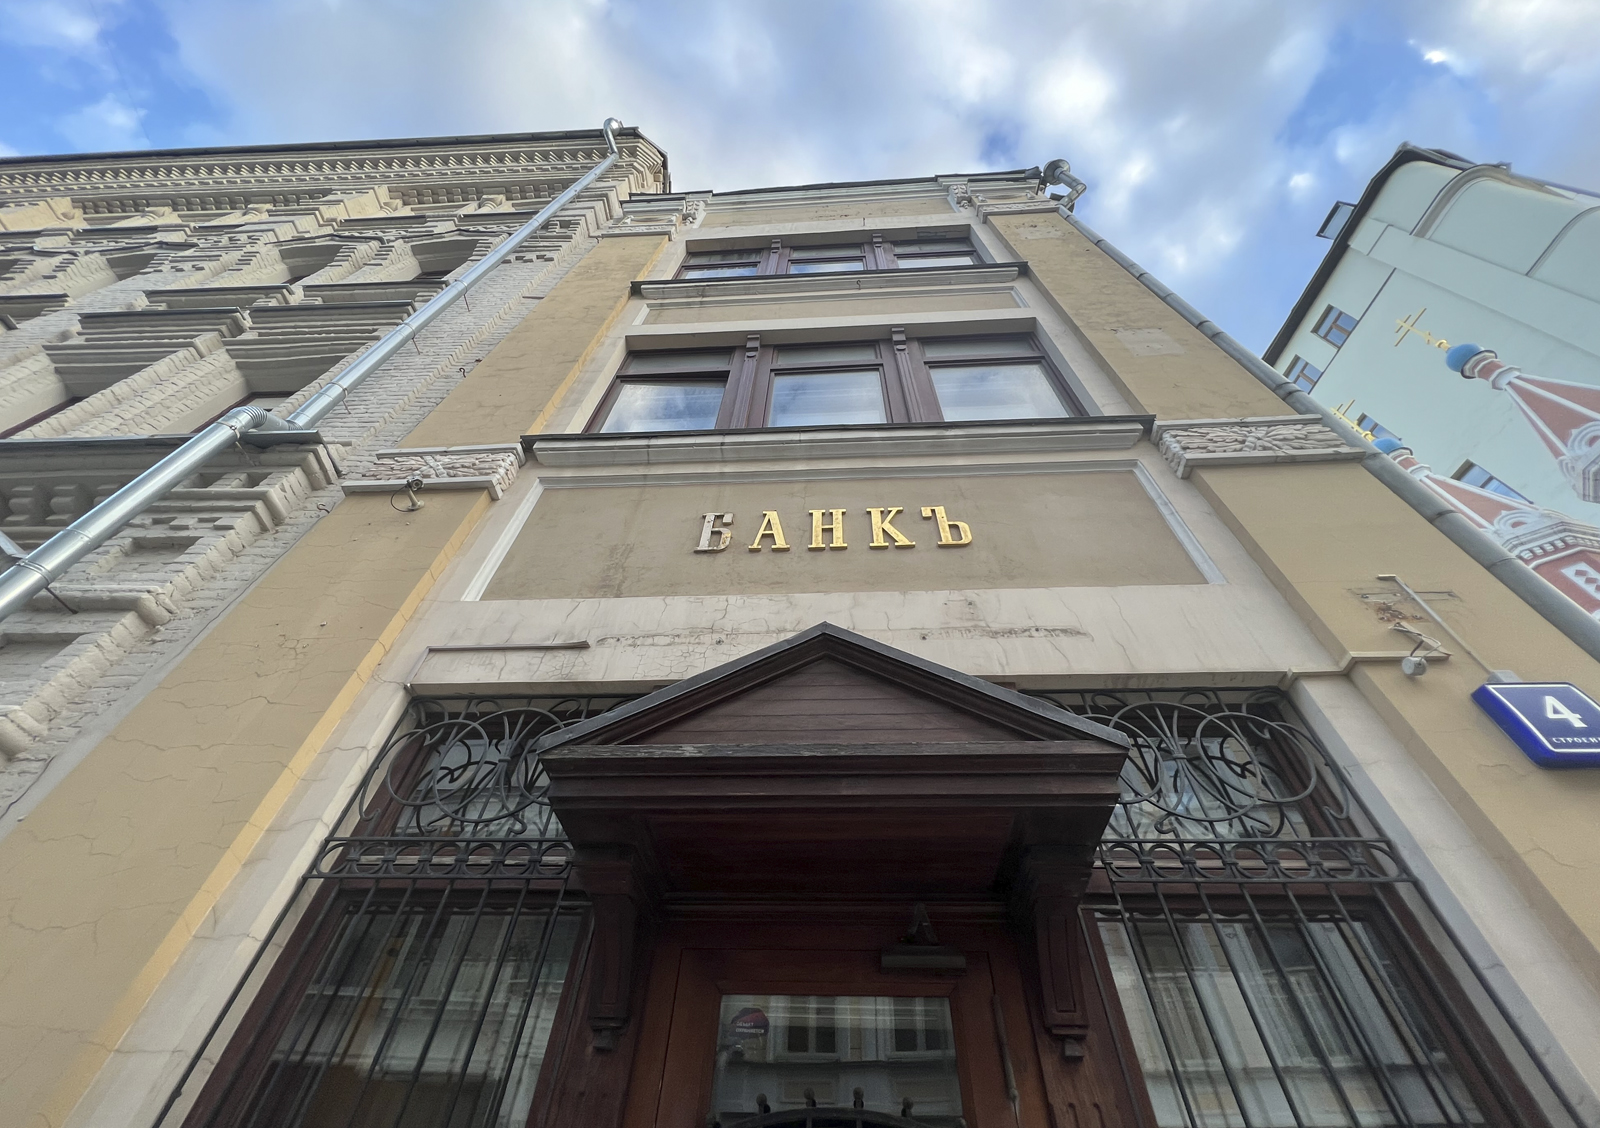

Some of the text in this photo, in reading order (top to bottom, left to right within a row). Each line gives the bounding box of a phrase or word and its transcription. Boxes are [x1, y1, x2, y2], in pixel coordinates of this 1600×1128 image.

[694, 505, 972, 552] БАНКЪ
[1545, 695, 1588, 728] 4
[1552, 736, 1600, 744] СТРОЕН
